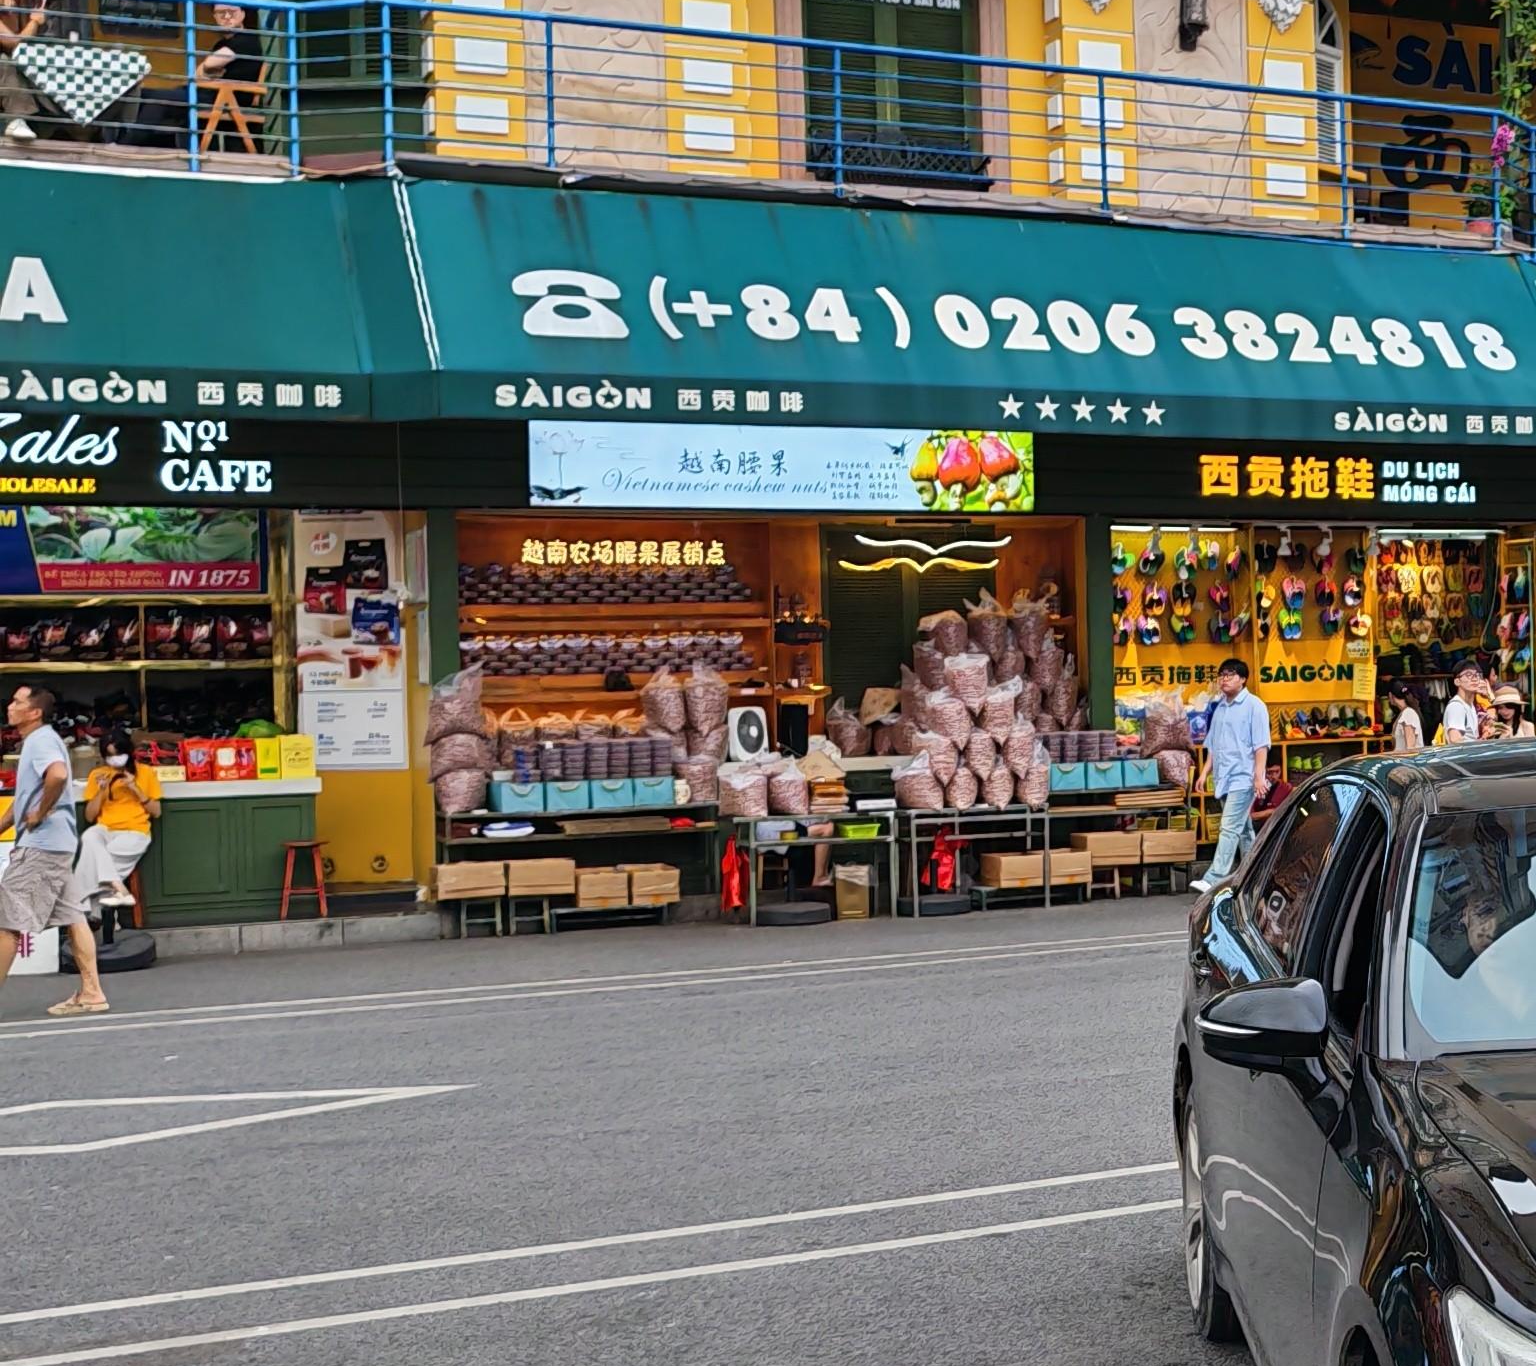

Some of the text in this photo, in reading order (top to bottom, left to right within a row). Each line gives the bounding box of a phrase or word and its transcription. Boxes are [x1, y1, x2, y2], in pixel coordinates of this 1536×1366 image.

[0, 256, 68, 325] A
[933, 293, 1157, 357] 0206
[1173, 306, 1518, 371] 3824818
[197, 381, 343, 408] 西贡咖啡
[494, 377, 804, 413] SÀIGÒN 西贡咖啡
[1334, 407, 1449, 433] SÀIGÒN
[678, 447, 789, 476] 越南腰果
[1382, 460, 1461, 482] DU LỊCH
[160, 459, 273, 494] CAFE
[601, 466, 719, 493] Vietnamese
[724, 476, 786, 494] cashew
[792, 478, 828, 495] nuts
[1199, 454, 1375, 500] 西贡拖鞋
[1382, 481, 1477, 504] MÓNG CÁI
[521, 538, 726, 566] 越南农场腰果展销点
[168, 568, 194, 587] IN
[200, 568, 251, 587] 1875
